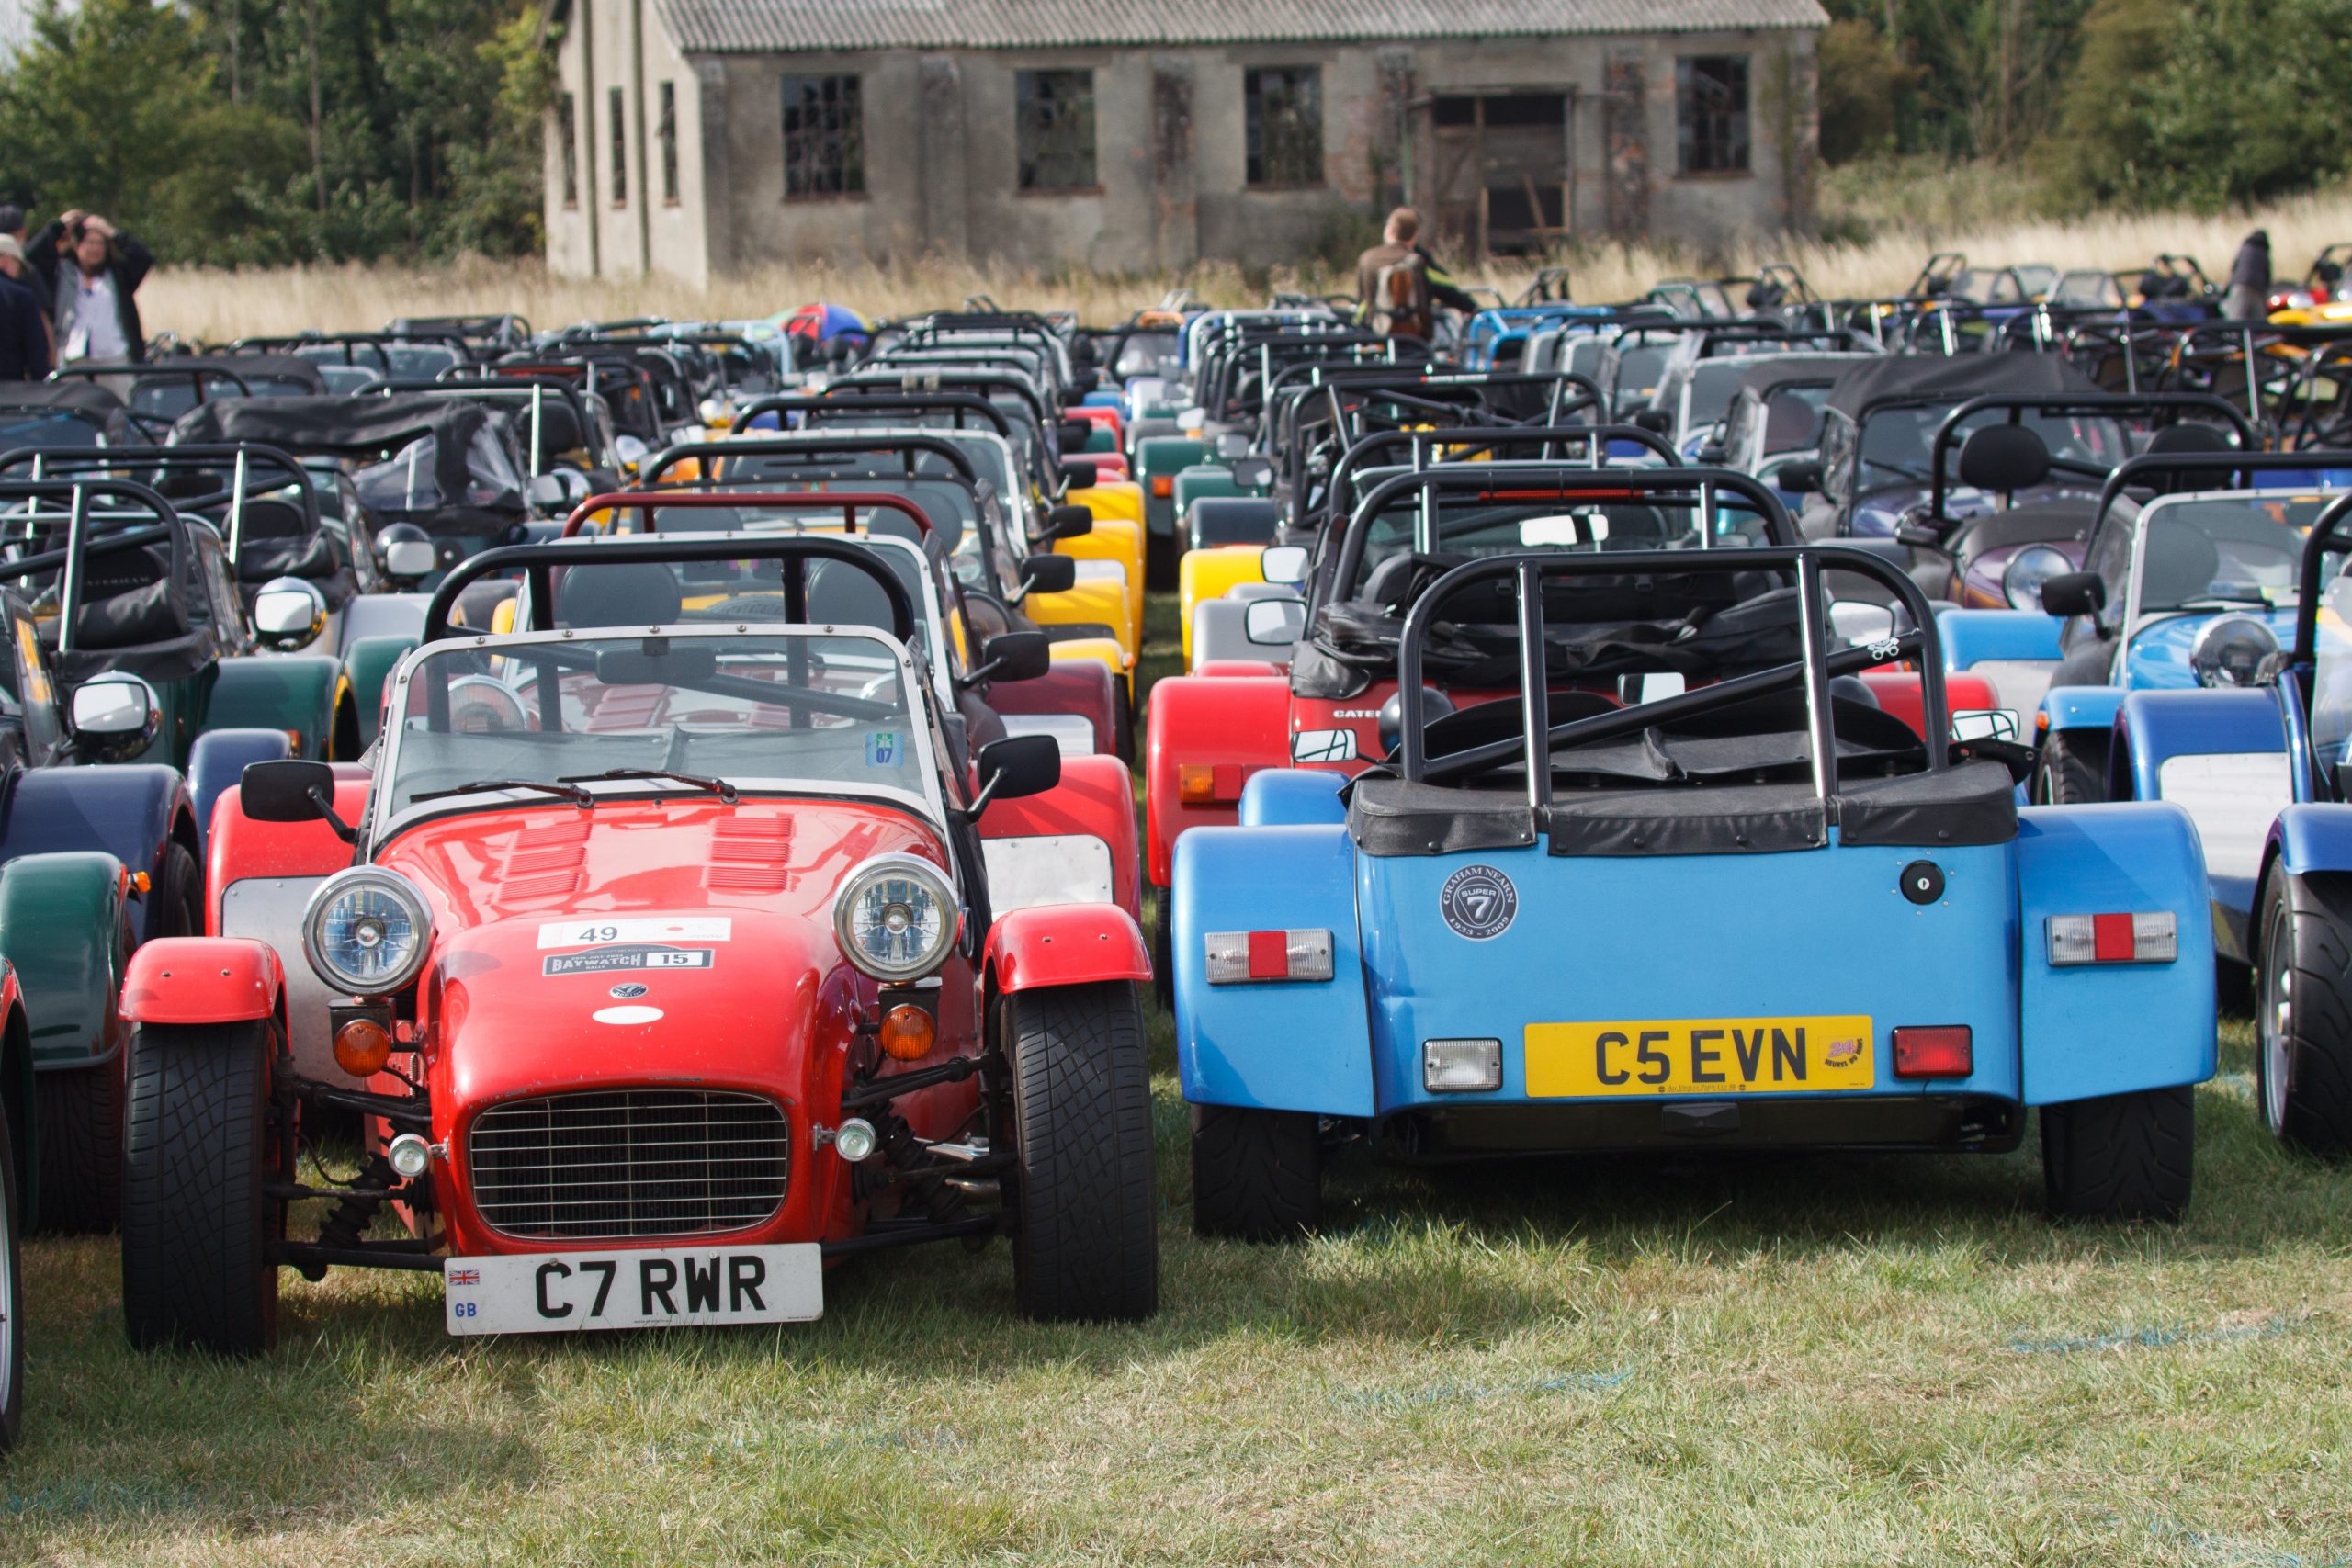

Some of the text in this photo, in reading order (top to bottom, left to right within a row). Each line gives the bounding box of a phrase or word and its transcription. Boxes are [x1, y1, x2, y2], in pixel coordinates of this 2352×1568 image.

[876, 749, 893, 763] 07
[1443, 867, 1514, 905] GRAHAM NEARN
[1461, 888, 1497, 897] SUPER
[1467, 896, 1492, 919] 7
[578, 926, 618, 942] 49
[1450, 917, 1474, 935] 1933
[1485, 917, 1509, 936] 2009
[551, 953, 641, 972] BAYWATCH
[661, 954, 689, 964] 15
[1595, 1027, 1807, 1085] C5 EVN
[1828, 1039, 1854, 1057] 24
[535, 1255, 767, 1319] C7 RWR
[455, 1303, 477, 1318] GB
